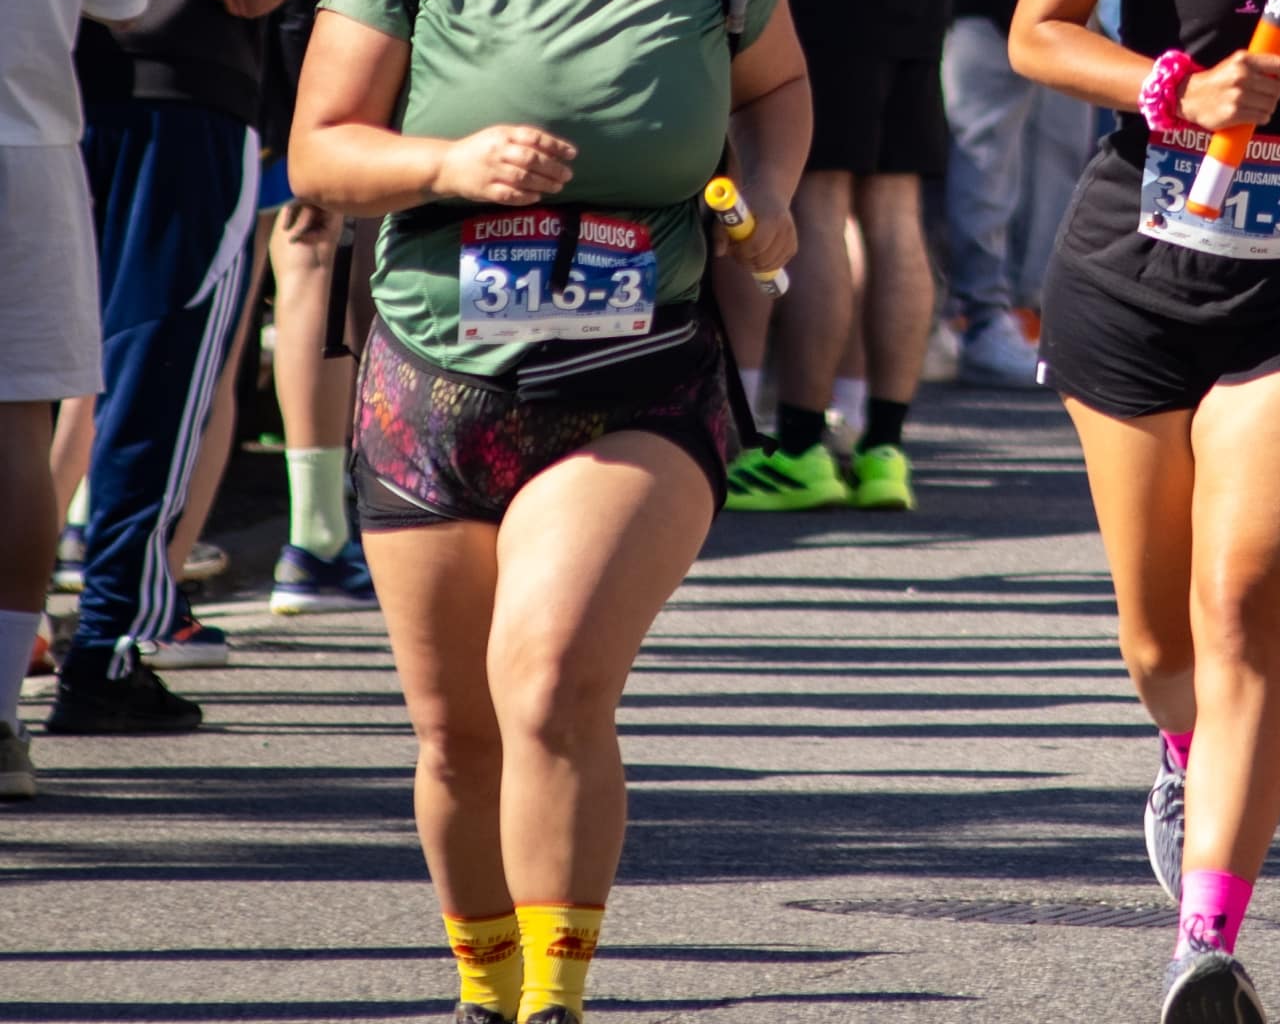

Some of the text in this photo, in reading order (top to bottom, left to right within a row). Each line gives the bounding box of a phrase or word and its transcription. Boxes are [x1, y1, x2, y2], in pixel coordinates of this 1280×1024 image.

[1174, 158, 1193, 174] LES
[474, 216, 536, 240] EKIDEN
[488, 248, 508, 262] LES
[473, 267, 643, 312] 316-3
